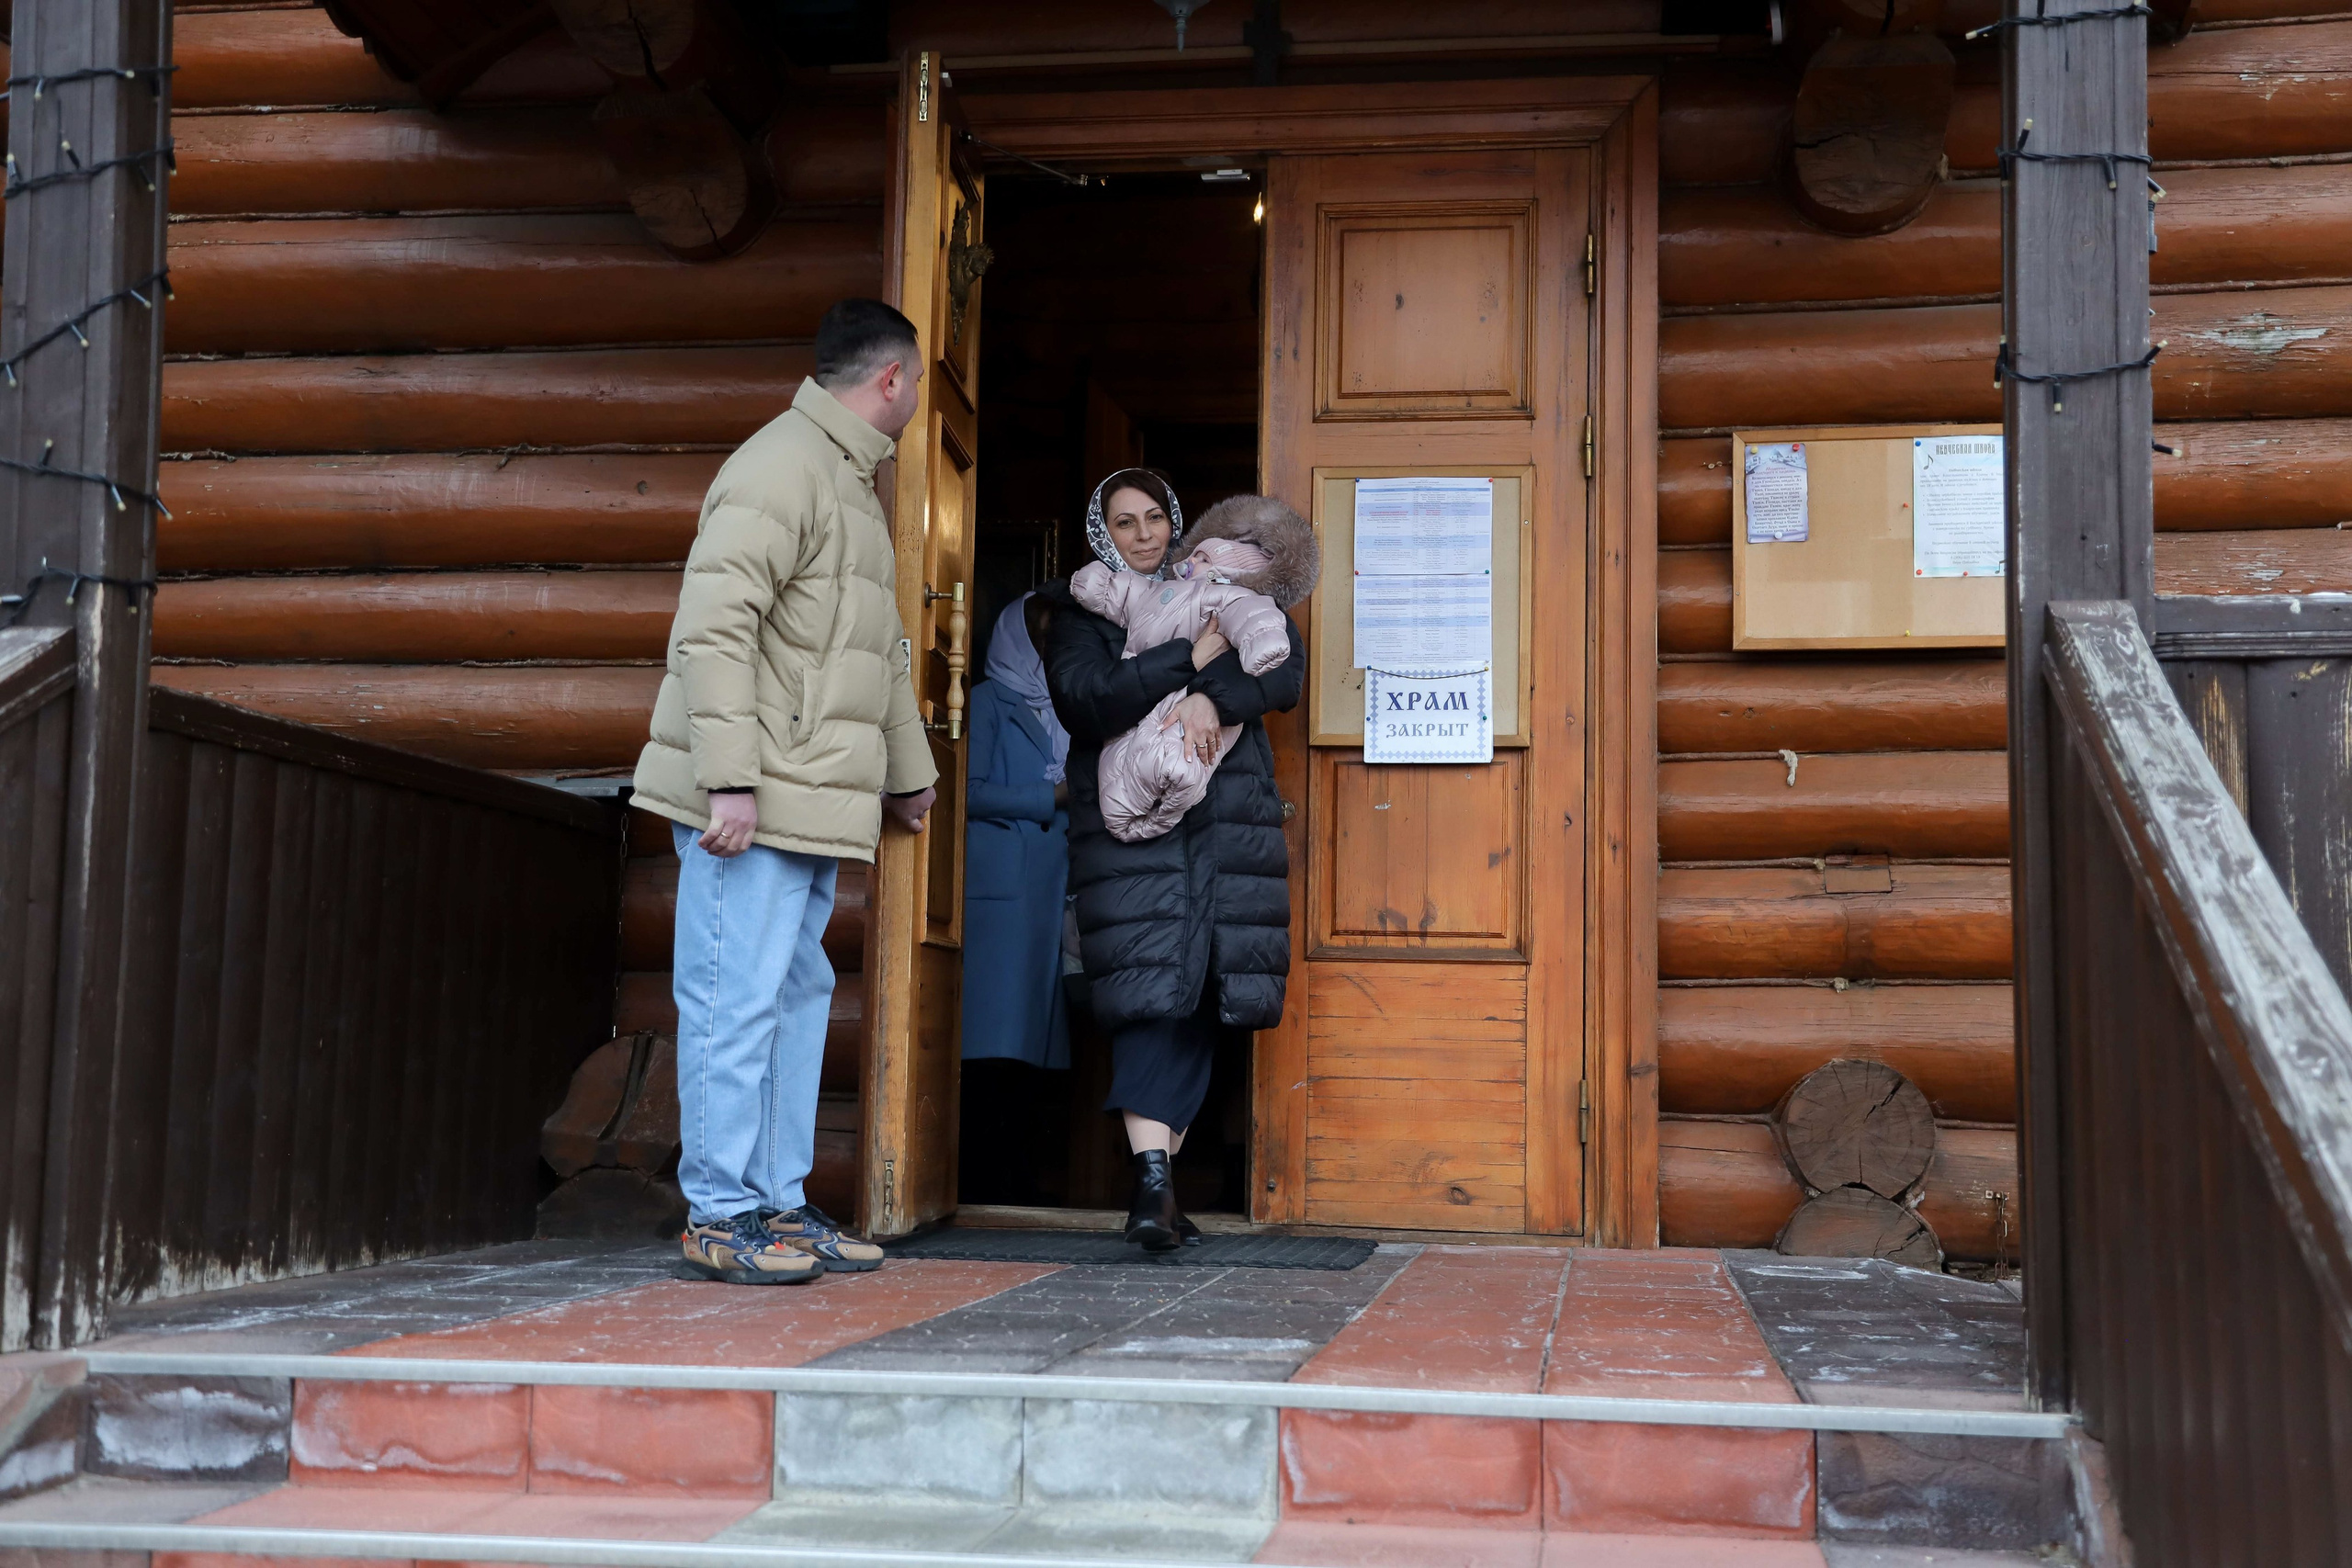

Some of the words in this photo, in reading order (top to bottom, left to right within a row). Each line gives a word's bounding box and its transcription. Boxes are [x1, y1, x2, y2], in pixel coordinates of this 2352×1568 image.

[1936, 444, 1972, 456] ПЕВЧЕСКАЯ
[1974, 443, 1996, 454] ШКОЛА
[1386, 692, 1470, 711] ХРАМ
[1385, 723, 1469, 739] ЗАКРЫТ
